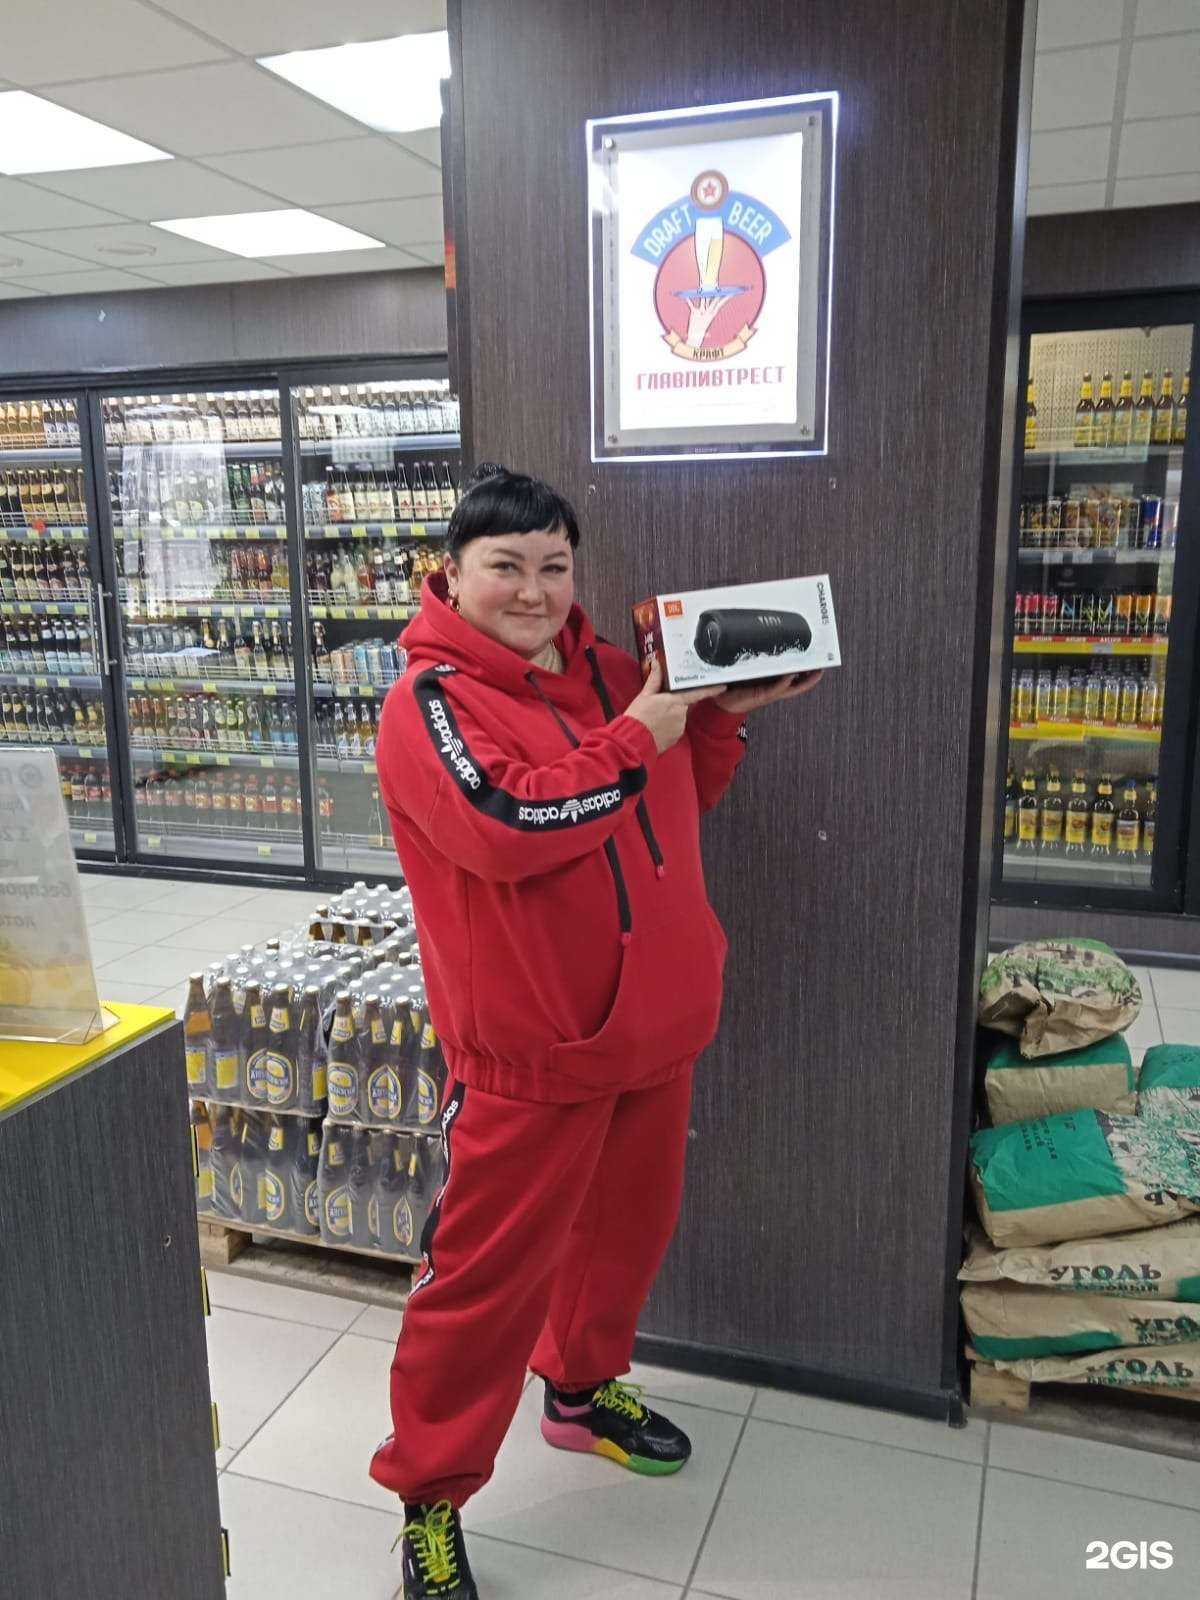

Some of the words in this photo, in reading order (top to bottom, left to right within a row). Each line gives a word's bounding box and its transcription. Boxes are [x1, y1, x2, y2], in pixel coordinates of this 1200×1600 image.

[643, 204, 692, 257] DRAFT
[728, 201, 773, 246] BEER
[637, 366, 785, 390] ГЛАВПИВТРЕСТ
[429, 699, 453, 744] adidas
[454, 756, 481, 790] adidas
[582, 789, 620, 811] adidas
[519, 806, 559, 824] adidas
[1048, 1264, 1161, 1281] УГОЛЬ
